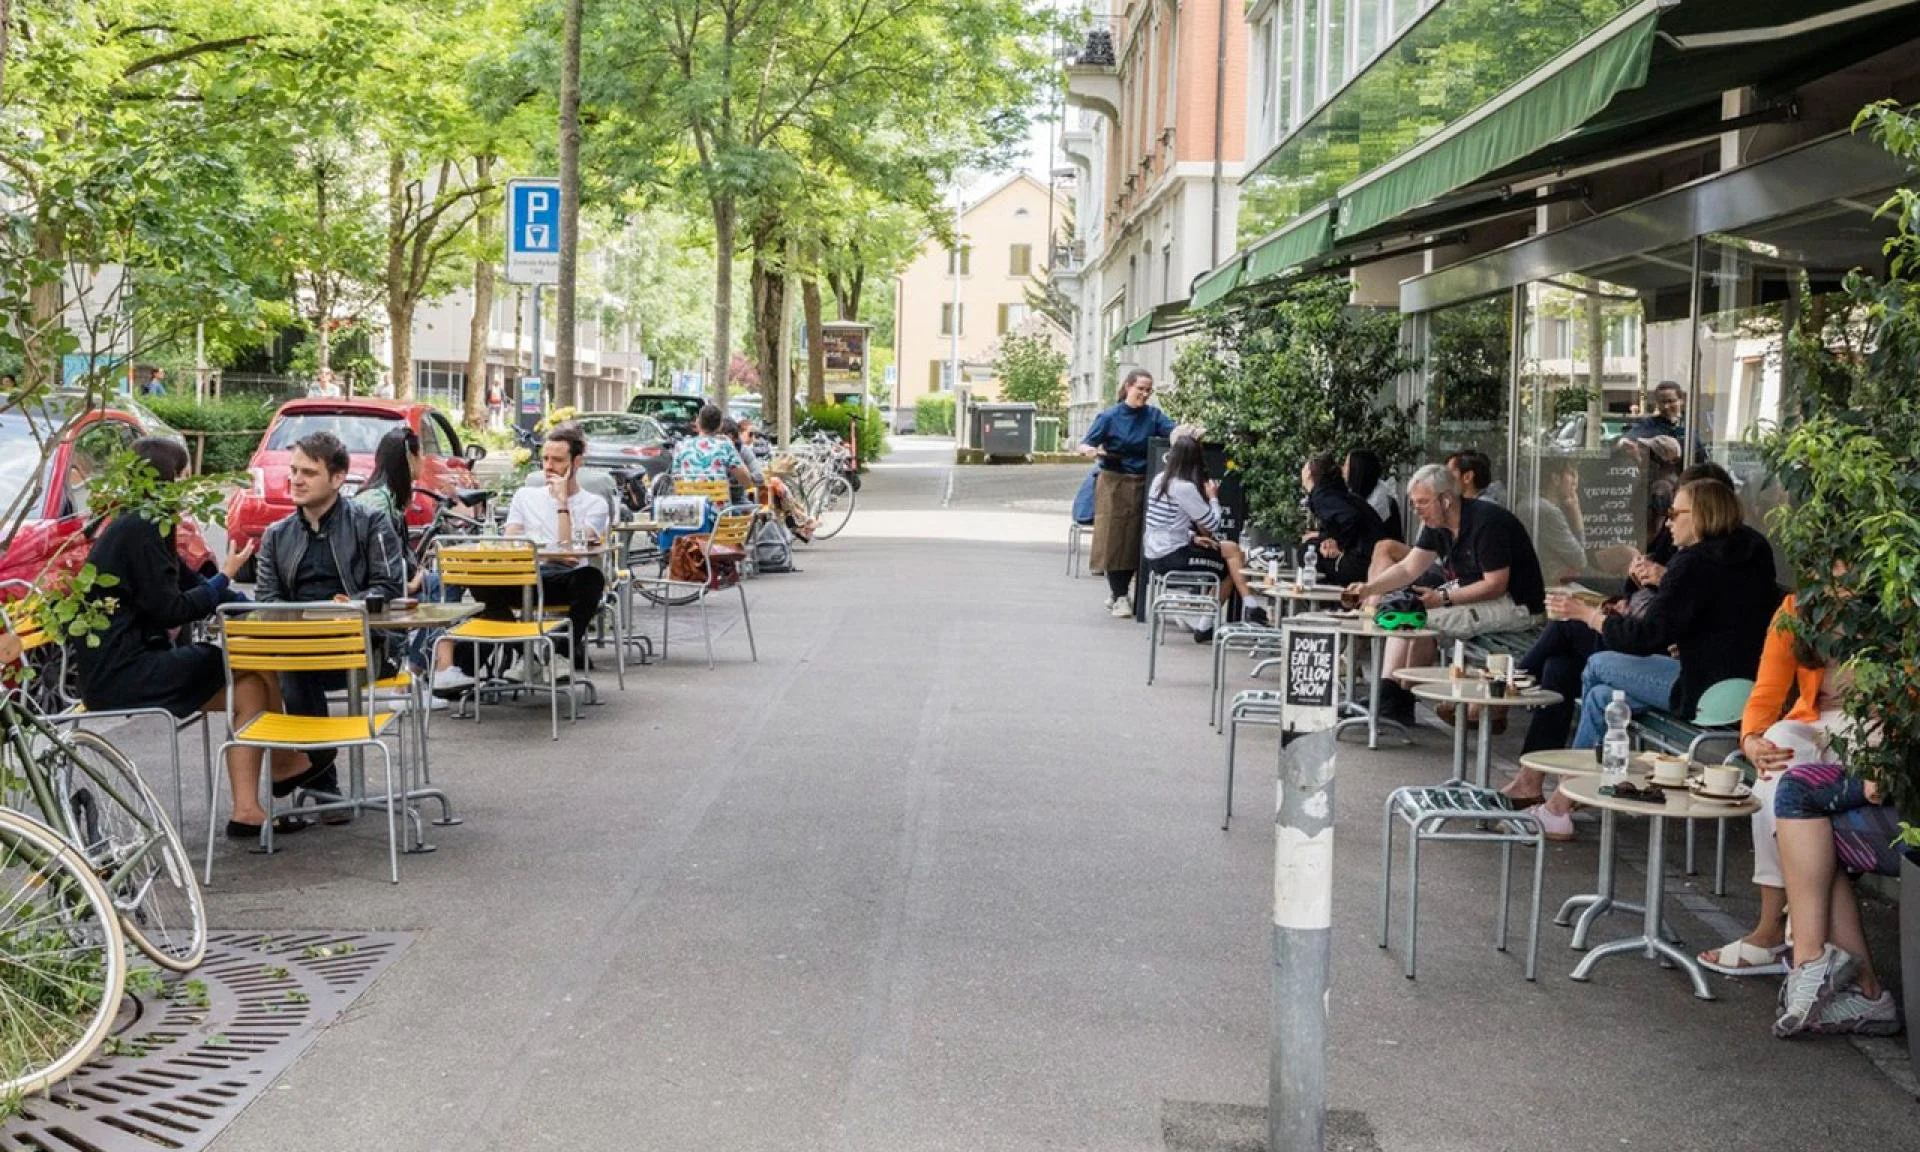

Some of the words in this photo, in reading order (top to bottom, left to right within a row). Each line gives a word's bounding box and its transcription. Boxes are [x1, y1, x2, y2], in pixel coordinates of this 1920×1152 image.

[527, 191, 549, 223] P
[1295, 637, 1328, 651] DON'T
[1291, 651, 1310, 666] EAT
[1313, 651, 1332, 667] THE
[1290, 665, 1331, 682] YELLOW
[1290, 682, 1327, 697] SNOW
